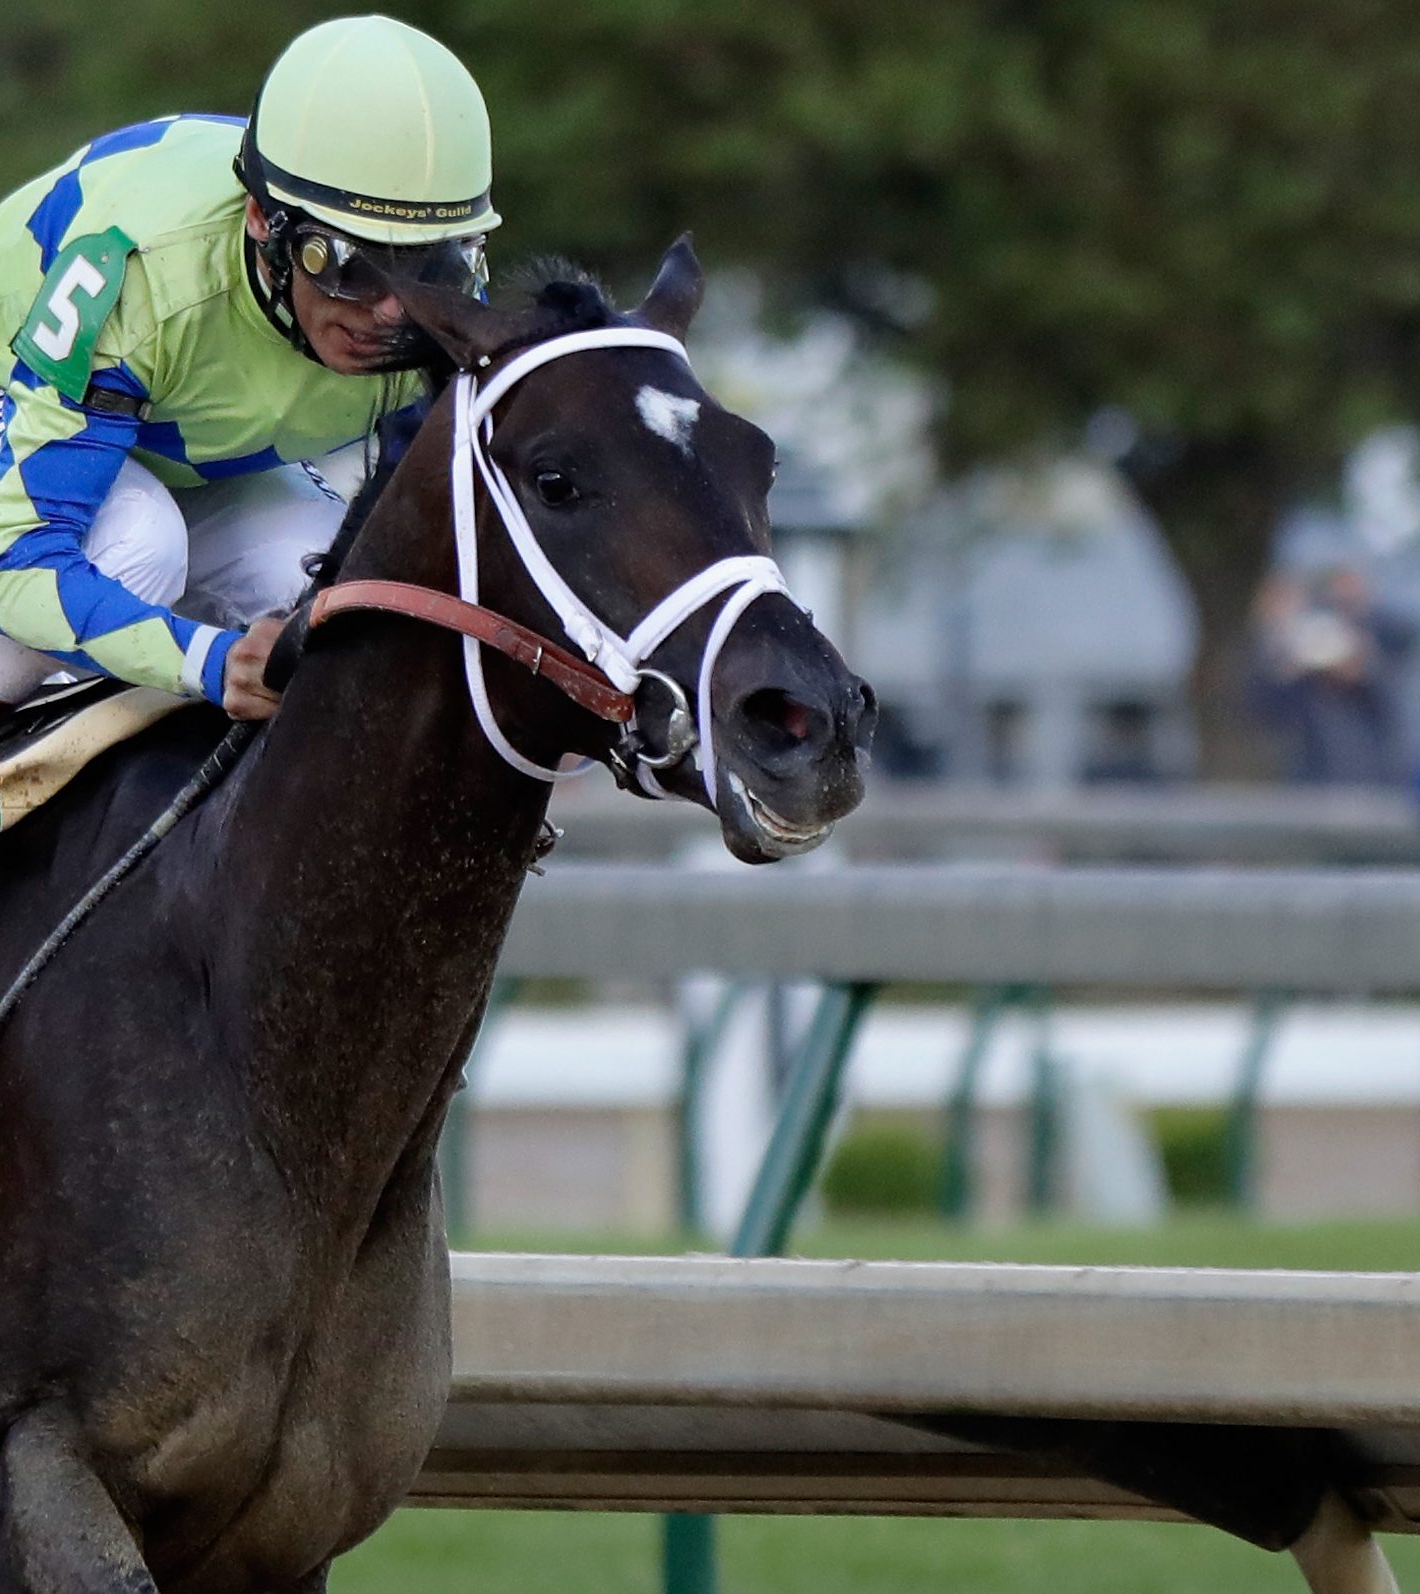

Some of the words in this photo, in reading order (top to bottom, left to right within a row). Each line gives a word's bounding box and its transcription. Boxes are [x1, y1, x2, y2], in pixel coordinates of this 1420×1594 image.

[349, 199, 432, 219] Jockeys'
[435, 205, 472, 218] Guild
[32, 254, 108, 362] 5
